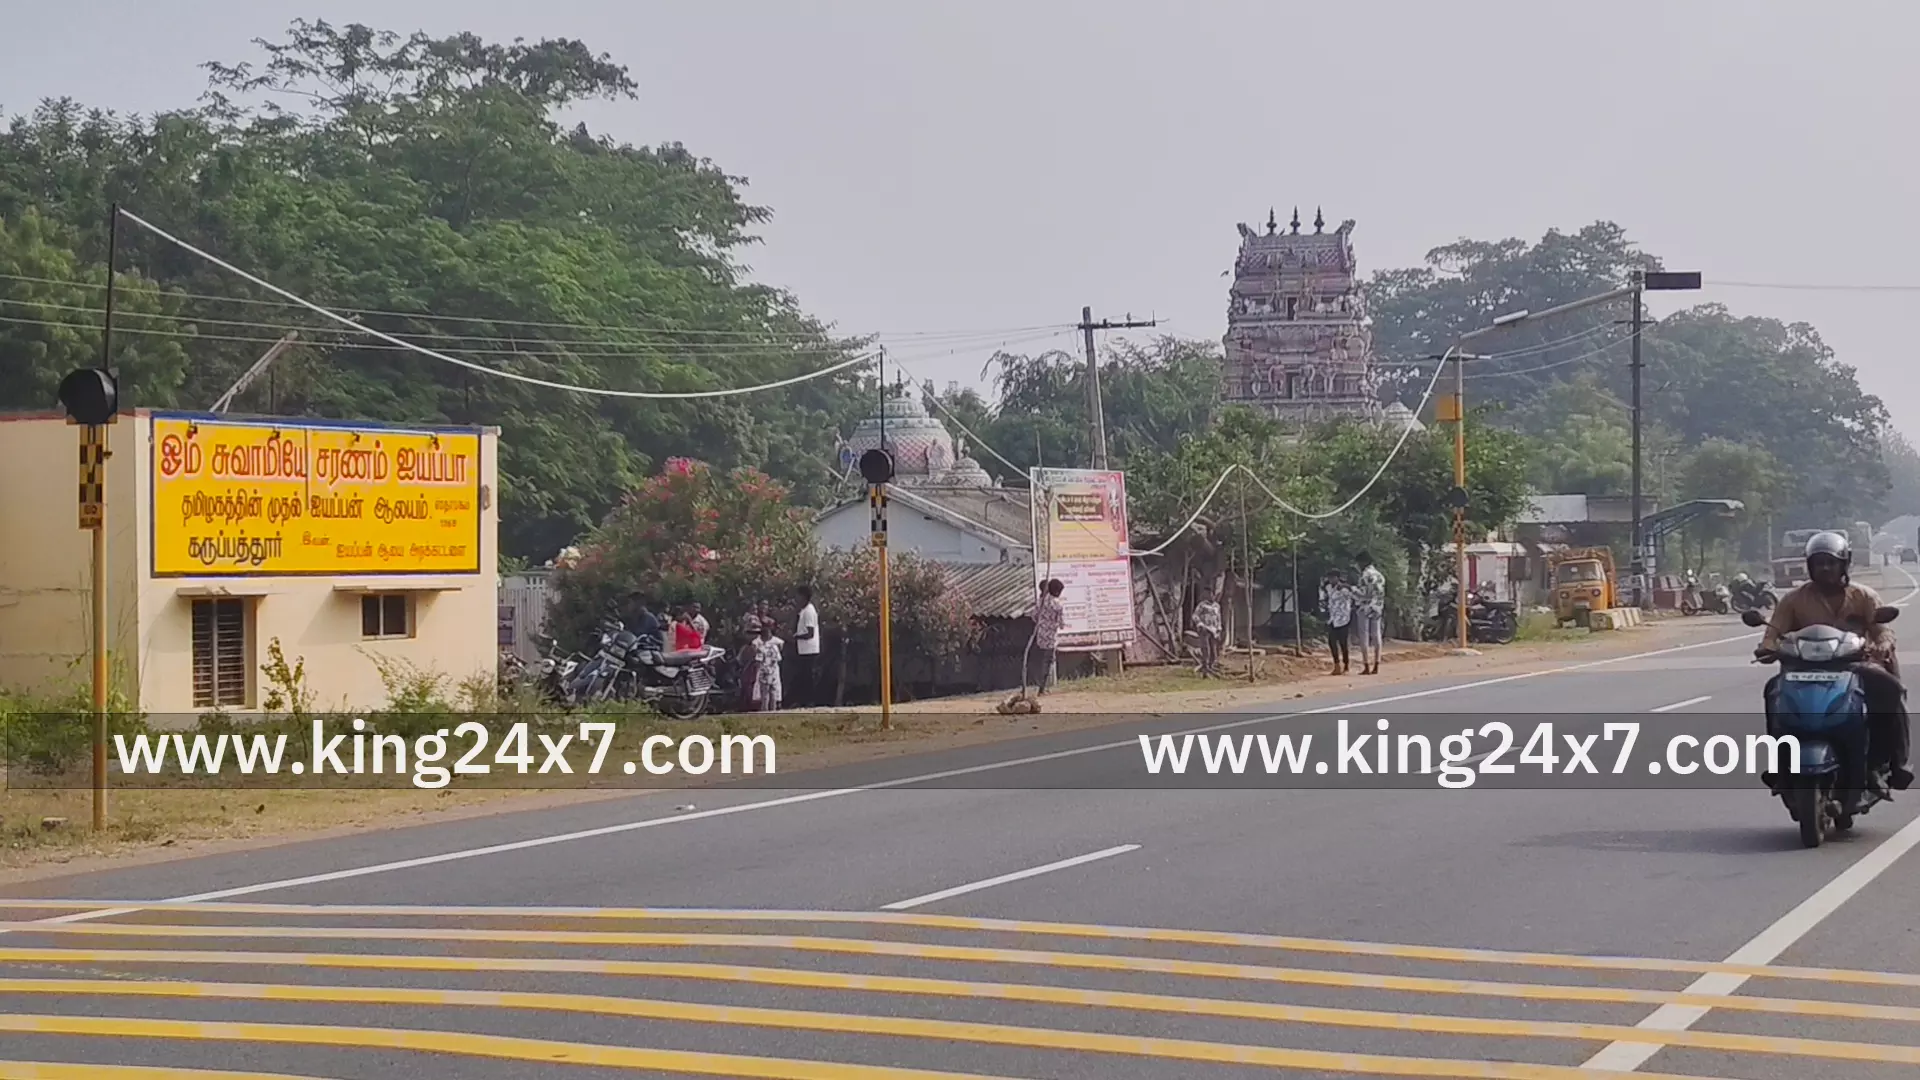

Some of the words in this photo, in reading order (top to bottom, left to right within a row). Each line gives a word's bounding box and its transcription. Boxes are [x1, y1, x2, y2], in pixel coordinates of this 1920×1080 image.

[212, 435, 308, 478] சுவாமியே
[316, 440, 388, 486] சரணம்
[396, 444, 467, 482] ஐயப்பா
[181, 488, 263, 527] தமிழகத்தின்
[267, 490, 303, 527] முதல்
[310, 492, 364, 519] ஐயப்பன்
[188, 529, 283, 566] கருப்பத்தூர்
